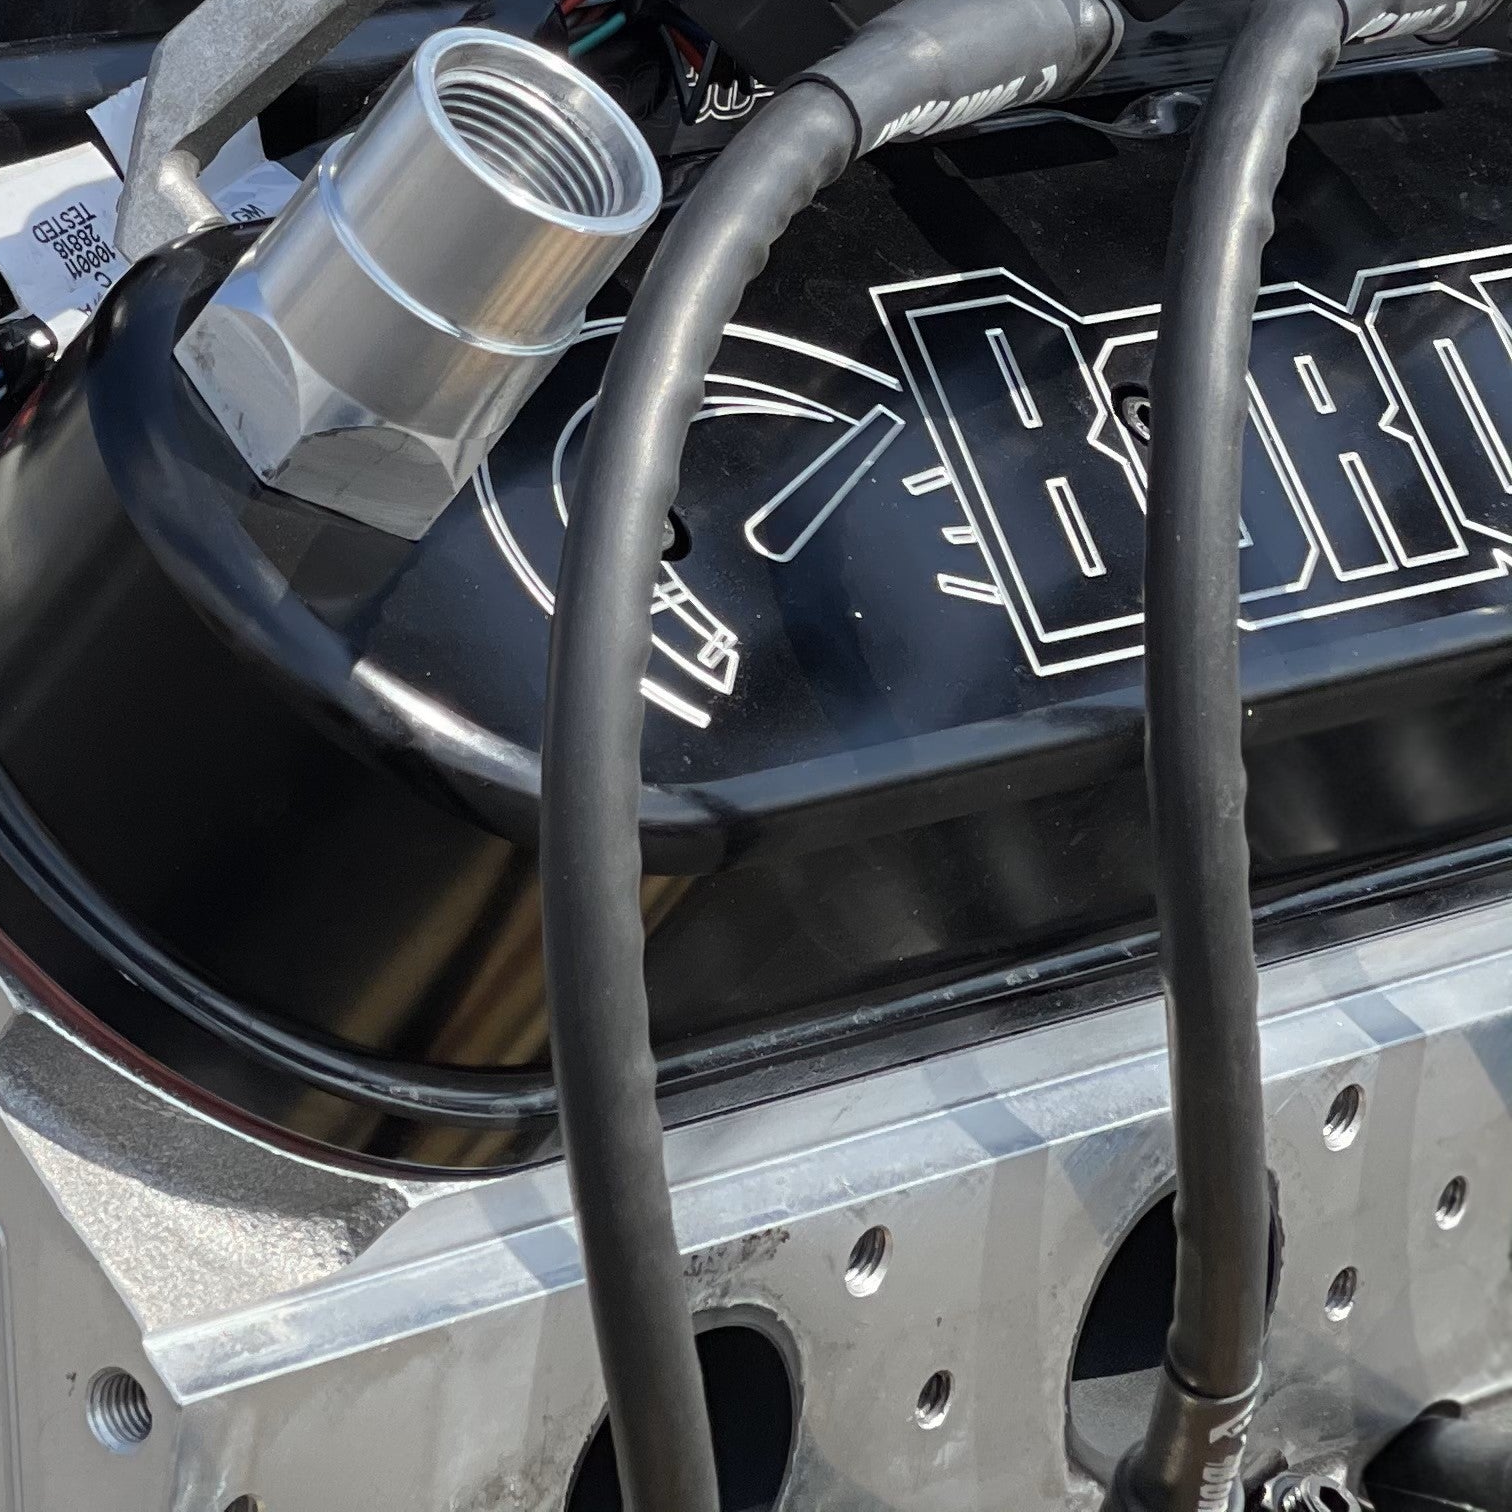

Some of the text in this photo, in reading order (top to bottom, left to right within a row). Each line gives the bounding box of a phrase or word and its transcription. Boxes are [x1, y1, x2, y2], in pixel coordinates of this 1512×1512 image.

[32, 201, 97, 244] TESTED
[53, 222, 101, 260] 28818
[64, 241, 116, 280] 100011
